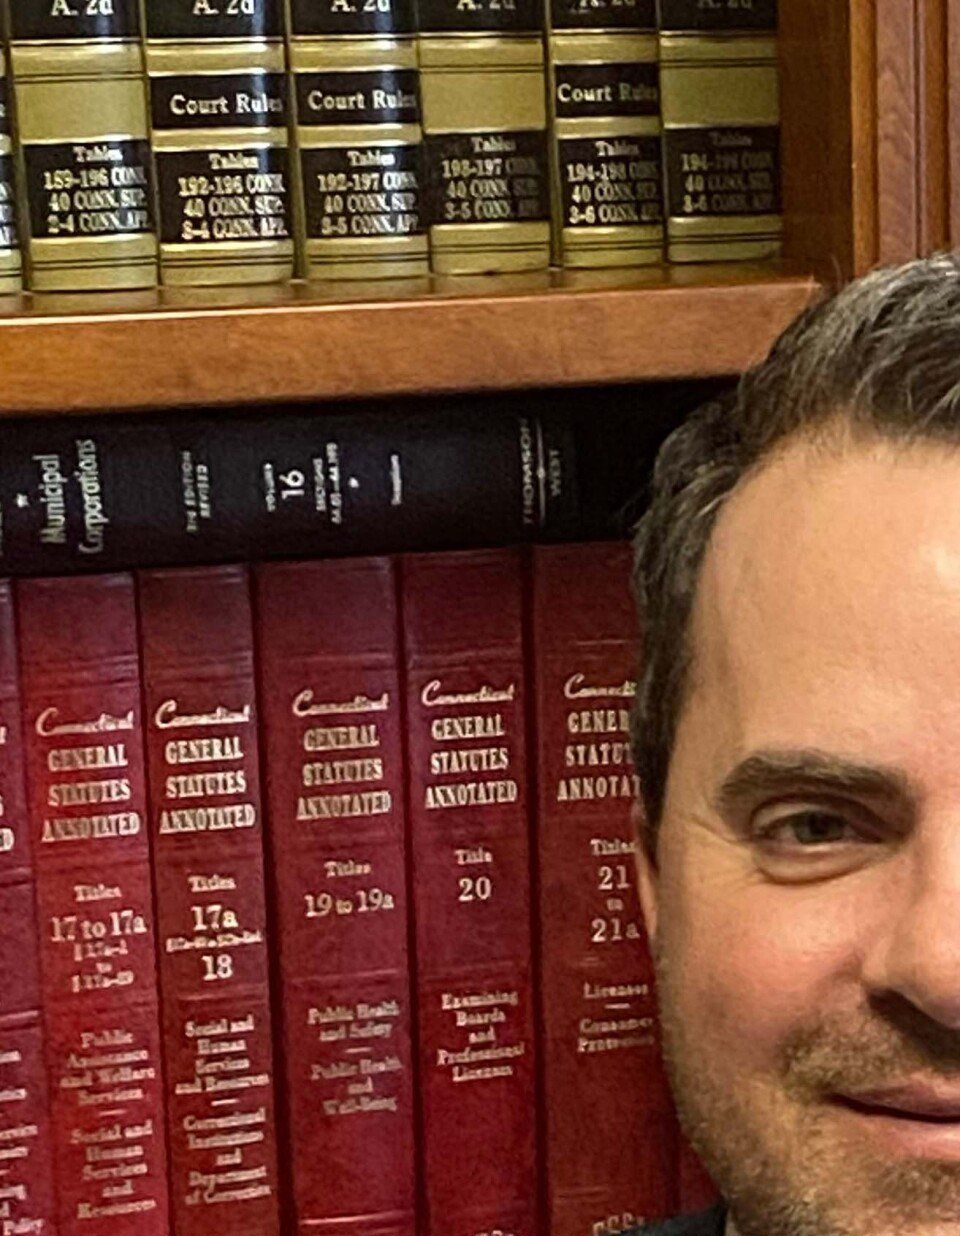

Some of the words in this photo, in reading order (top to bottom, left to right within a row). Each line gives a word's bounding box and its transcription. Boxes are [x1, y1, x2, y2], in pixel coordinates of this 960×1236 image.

[170, 94, 229, 114] Court
[236, 92, 283, 112] Rules
[308, 90, 365, 110] Court
[557, 83, 612, 101] Court
[32, 454, 68, 543] Municipal
[74, 439, 109, 553] Corporations
[279, 469, 305, 500] 16
[431, 714, 505, 741] GENERAL
[568, 709, 629, 734] GENER
[165, 736, 244, 764] GENERAL
[304, 725, 380, 752] GENERAL
[49, 744, 128, 772] GENERAL
[303, 758, 383, 786] STATUTES
[430, 748, 508, 775] STATUTES
[49, 779, 130, 807] STATUTES
[166, 770, 247, 798] STATUTES
[425, 780, 518, 809] ANNOTATED
[557, 774, 641, 802] ANNOTAT
[159, 803, 255, 835] ANNOTATED
[296, 790, 392, 821] ANNOTATED
[41, 812, 141, 843] ANNOTATED
[324, 860, 371, 878] Titles
[598, 865, 631, 890] 21
[304, 893, 332, 918] 19
[336, 899, 353, 914] to
[356, 888, 394, 912] 19a
[458, 876, 492, 902] 20
[50, 916, 76, 942] 17
[81, 920, 106, 938] to
[109, 910, 147, 936] 17a
[191, 904, 238, 931] 17a
[591, 918, 640, 942] 21a
[201, 954, 233, 981] 18
